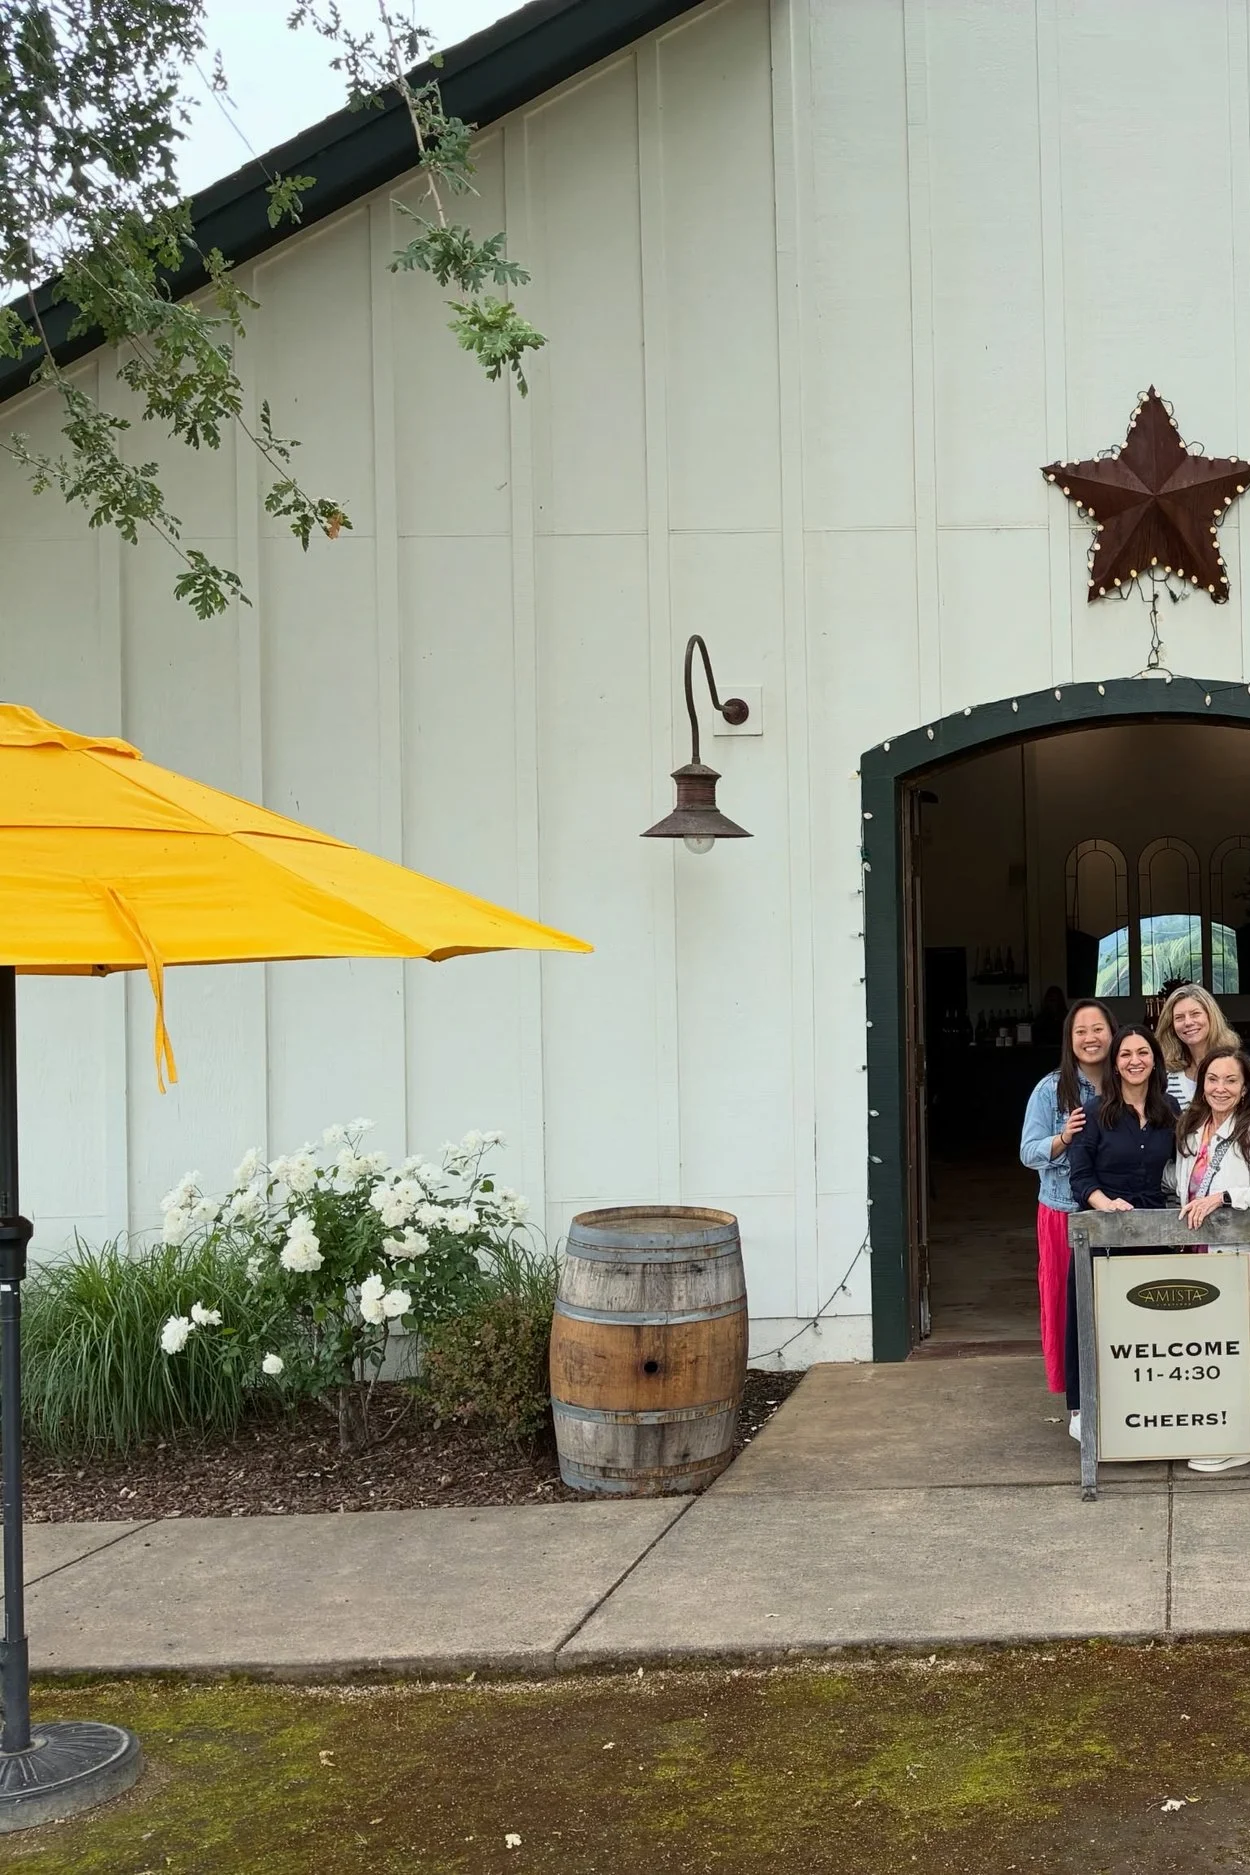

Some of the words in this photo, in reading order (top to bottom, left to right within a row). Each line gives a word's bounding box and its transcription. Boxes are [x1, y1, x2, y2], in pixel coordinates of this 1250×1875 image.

[1144, 1289, 1202, 1303] AMISTA
[1110, 1340, 1240, 1360] WELCOME
[1125, 1410, 1227, 1428] CHEERS!
